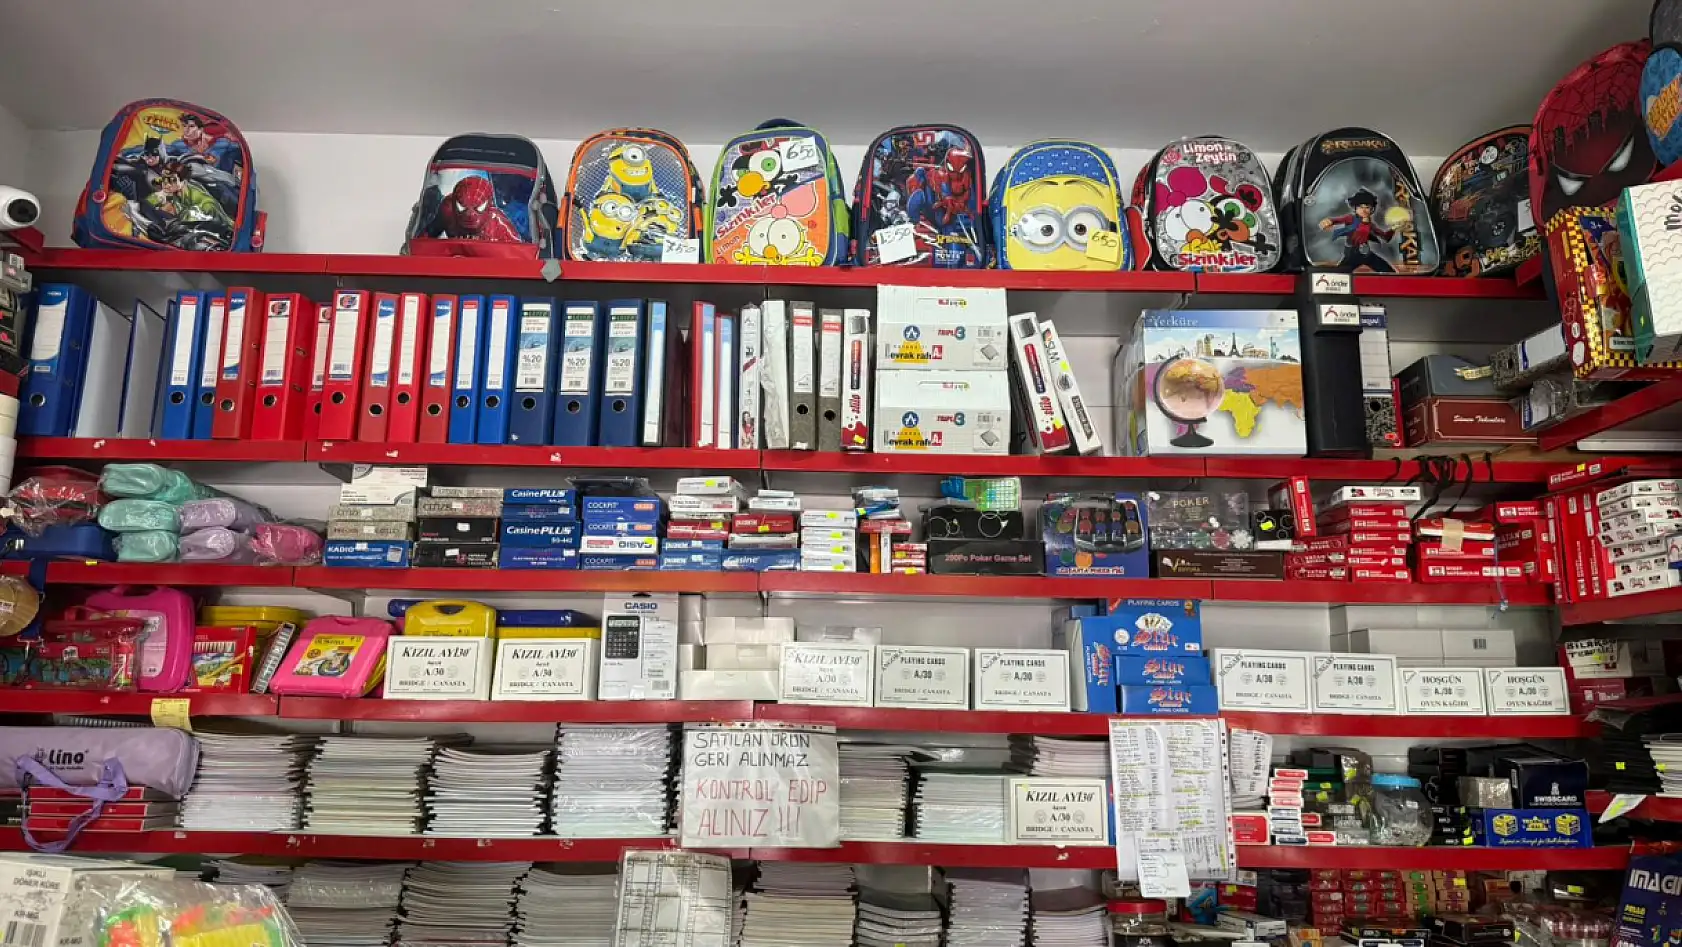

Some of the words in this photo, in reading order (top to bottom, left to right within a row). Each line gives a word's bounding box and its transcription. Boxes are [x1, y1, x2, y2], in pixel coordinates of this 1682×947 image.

[786, 142, 815, 160] 650
[1183, 143, 1222, 154] Limon
[1196, 152, 1237, 165] Zeytin
[1091, 231, 1118, 248] 650
[1179, 251, 1257, 266] Sizinkiler
[890, 352, 914, 361] evrak
[888, 438, 914, 447] evrak
[1173, 496, 1209, 508] POKER
[970, 553, 993, 563] Poker
[994, 553, 1017, 563] Game
[1018, 553, 1032, 563] Set
[624, 602, 658, 610] CASIO
[900, 656, 925, 665] PLAYING
[926, 657, 946, 665] CARDS
[1000, 658, 1025, 667] PLAYING
[1026, 659, 1046, 668] CARDS
[1240, 661, 1265, 670] PLAYING
[1267, 661, 1287, 671] CARDS
[1333, 663, 1356, 672] PLAYING
[1357, 665, 1375, 673] CARDS
[913, 670, 933, 679] A/30
[1013, 672, 1033, 682] A/30
[1256, 674, 1273, 684] A/30
[1347, 675, 1364, 685] A/30
[693, 732, 762, 748] SATILAN
[738, 751, 810, 768] ALINMAZ
[695, 779, 773, 802] KONTROL
[788, 776, 827, 804] EDİP
[697, 808, 769, 837] ALINIZ
